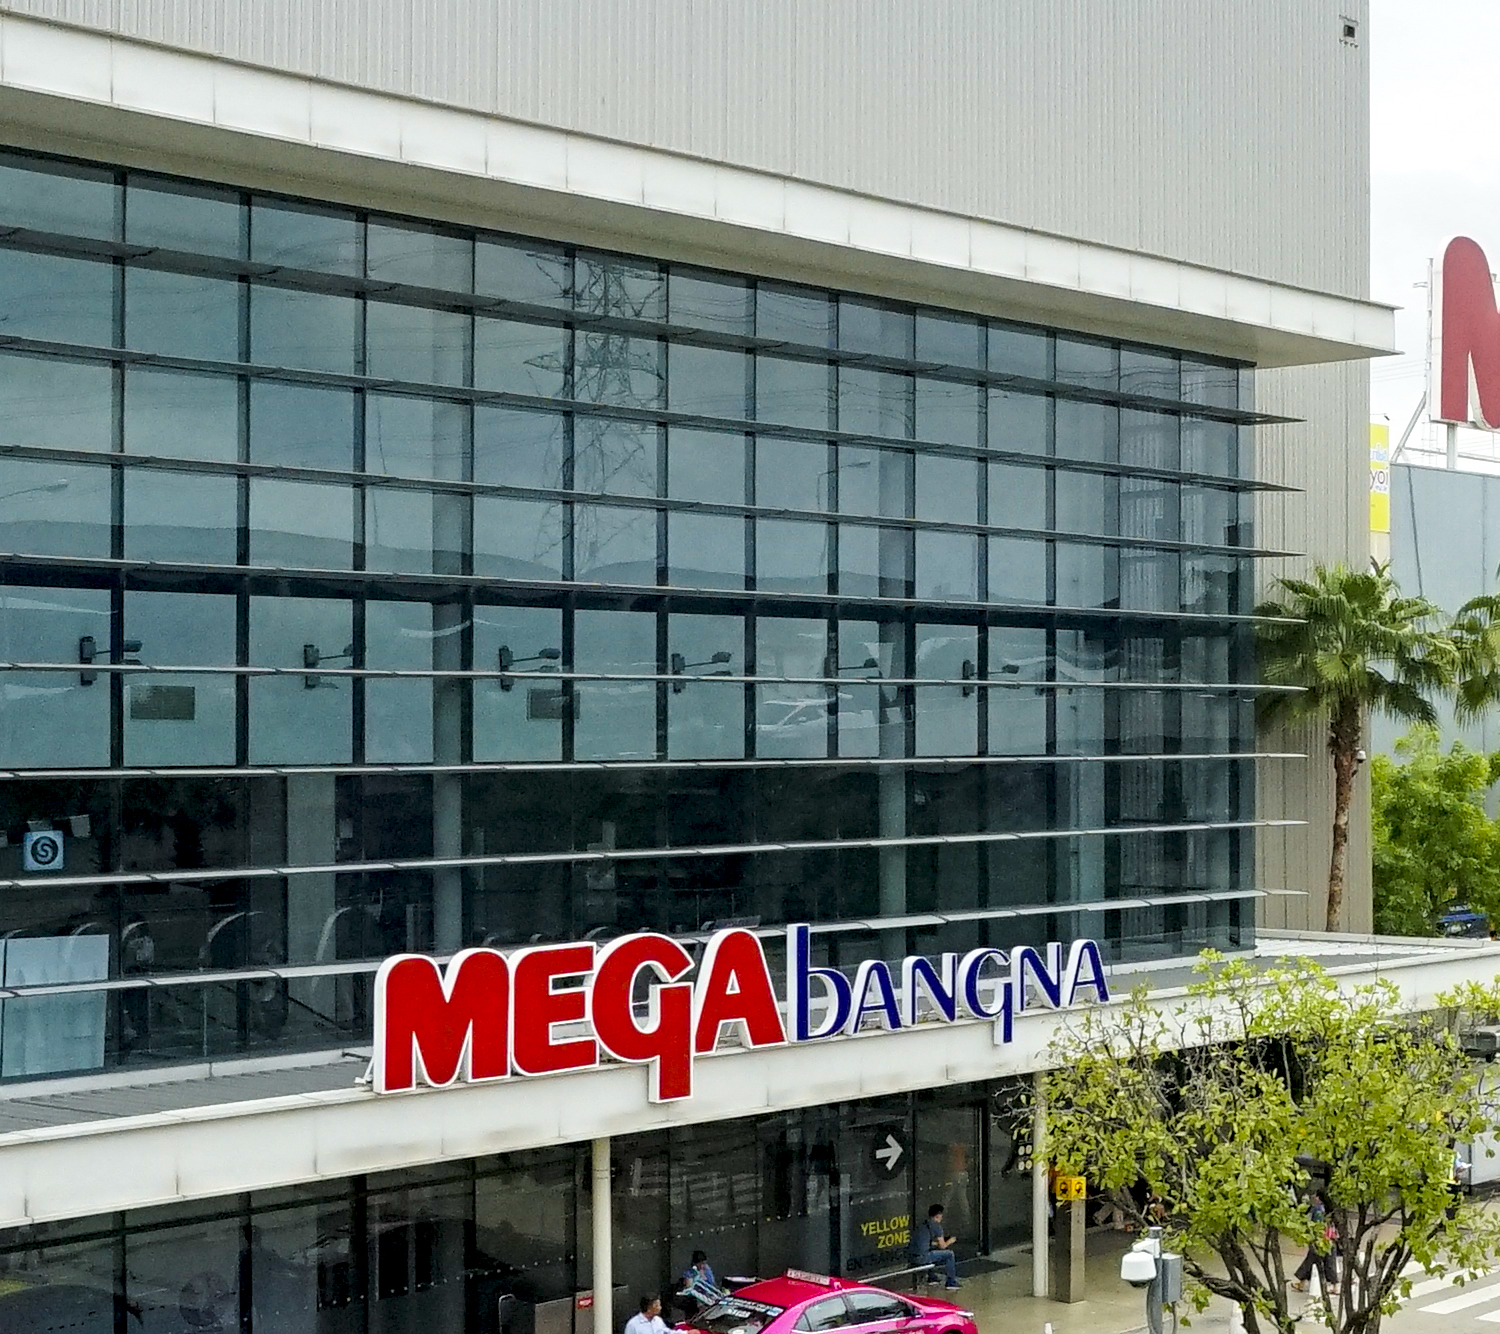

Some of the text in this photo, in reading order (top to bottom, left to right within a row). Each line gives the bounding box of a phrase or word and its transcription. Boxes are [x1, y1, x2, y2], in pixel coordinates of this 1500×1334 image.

[373, 926, 787, 1104] MEGA
[860, 1214, 911, 1236] YELLOW
[877, 1229, 911, 1249] ZONE
